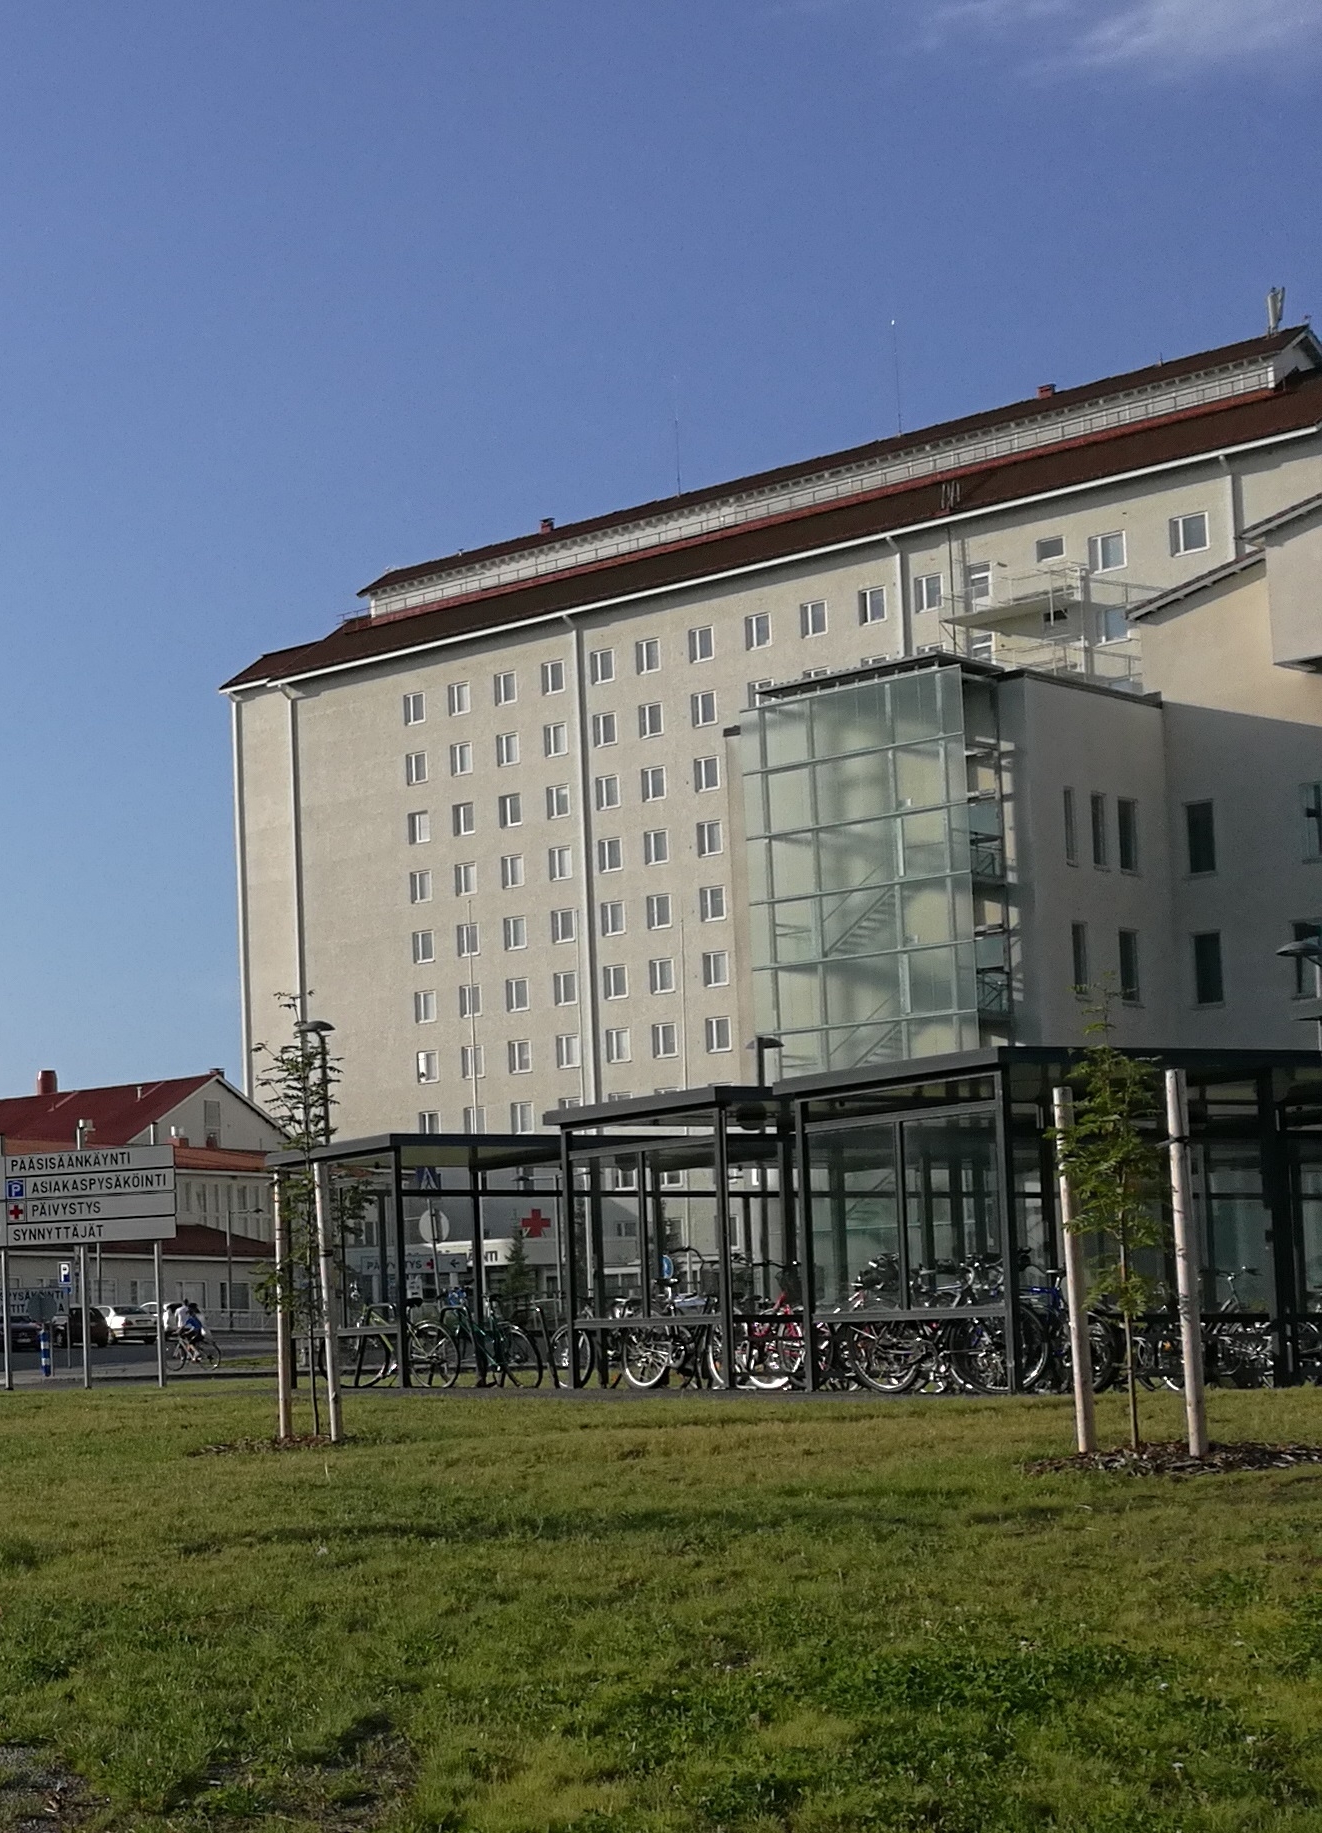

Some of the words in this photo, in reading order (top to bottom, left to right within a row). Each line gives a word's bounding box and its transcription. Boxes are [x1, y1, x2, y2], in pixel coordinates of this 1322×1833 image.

[11, 1152, 130, 1172] PÄÄSISÄÄNKÄYNTI
[12, 1184, 21, 1196] P
[31, 1173, 167, 1194] ASIAKASPYSÄKÖINTI
[31, 1201, 102, 1217] PÄIVYSTYS
[13, 1224, 104, 1241] SYNNYTTÄJÄT
[61, 1263, 70, 1282] P
